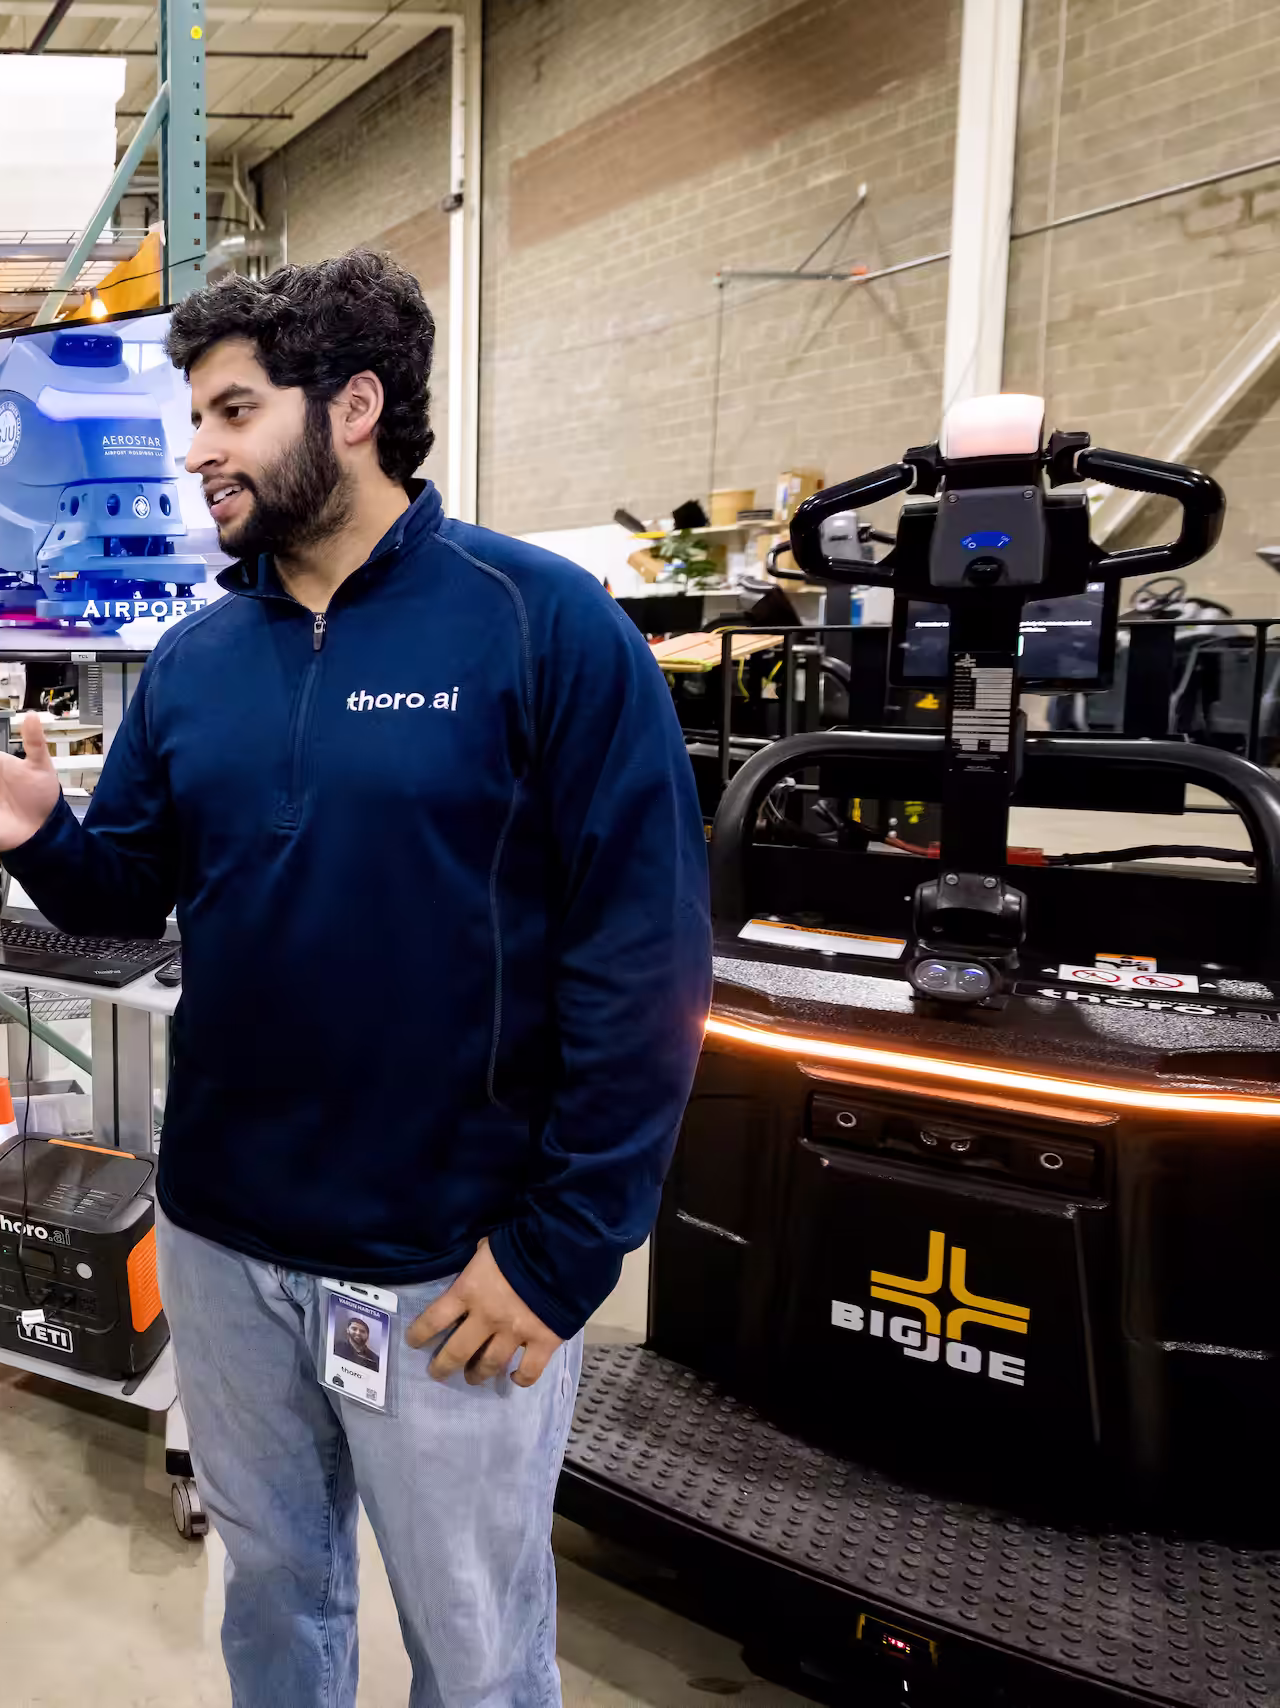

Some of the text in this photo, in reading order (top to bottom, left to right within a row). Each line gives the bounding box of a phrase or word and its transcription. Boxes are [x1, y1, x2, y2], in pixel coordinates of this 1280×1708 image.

[102, 435, 162, 447] AEROSTAR
[346, 686, 460, 711] thoro.ai
[1037, 988, 1280, 1023] thoro.a
[23, 1323, 69, 1347] YETI
